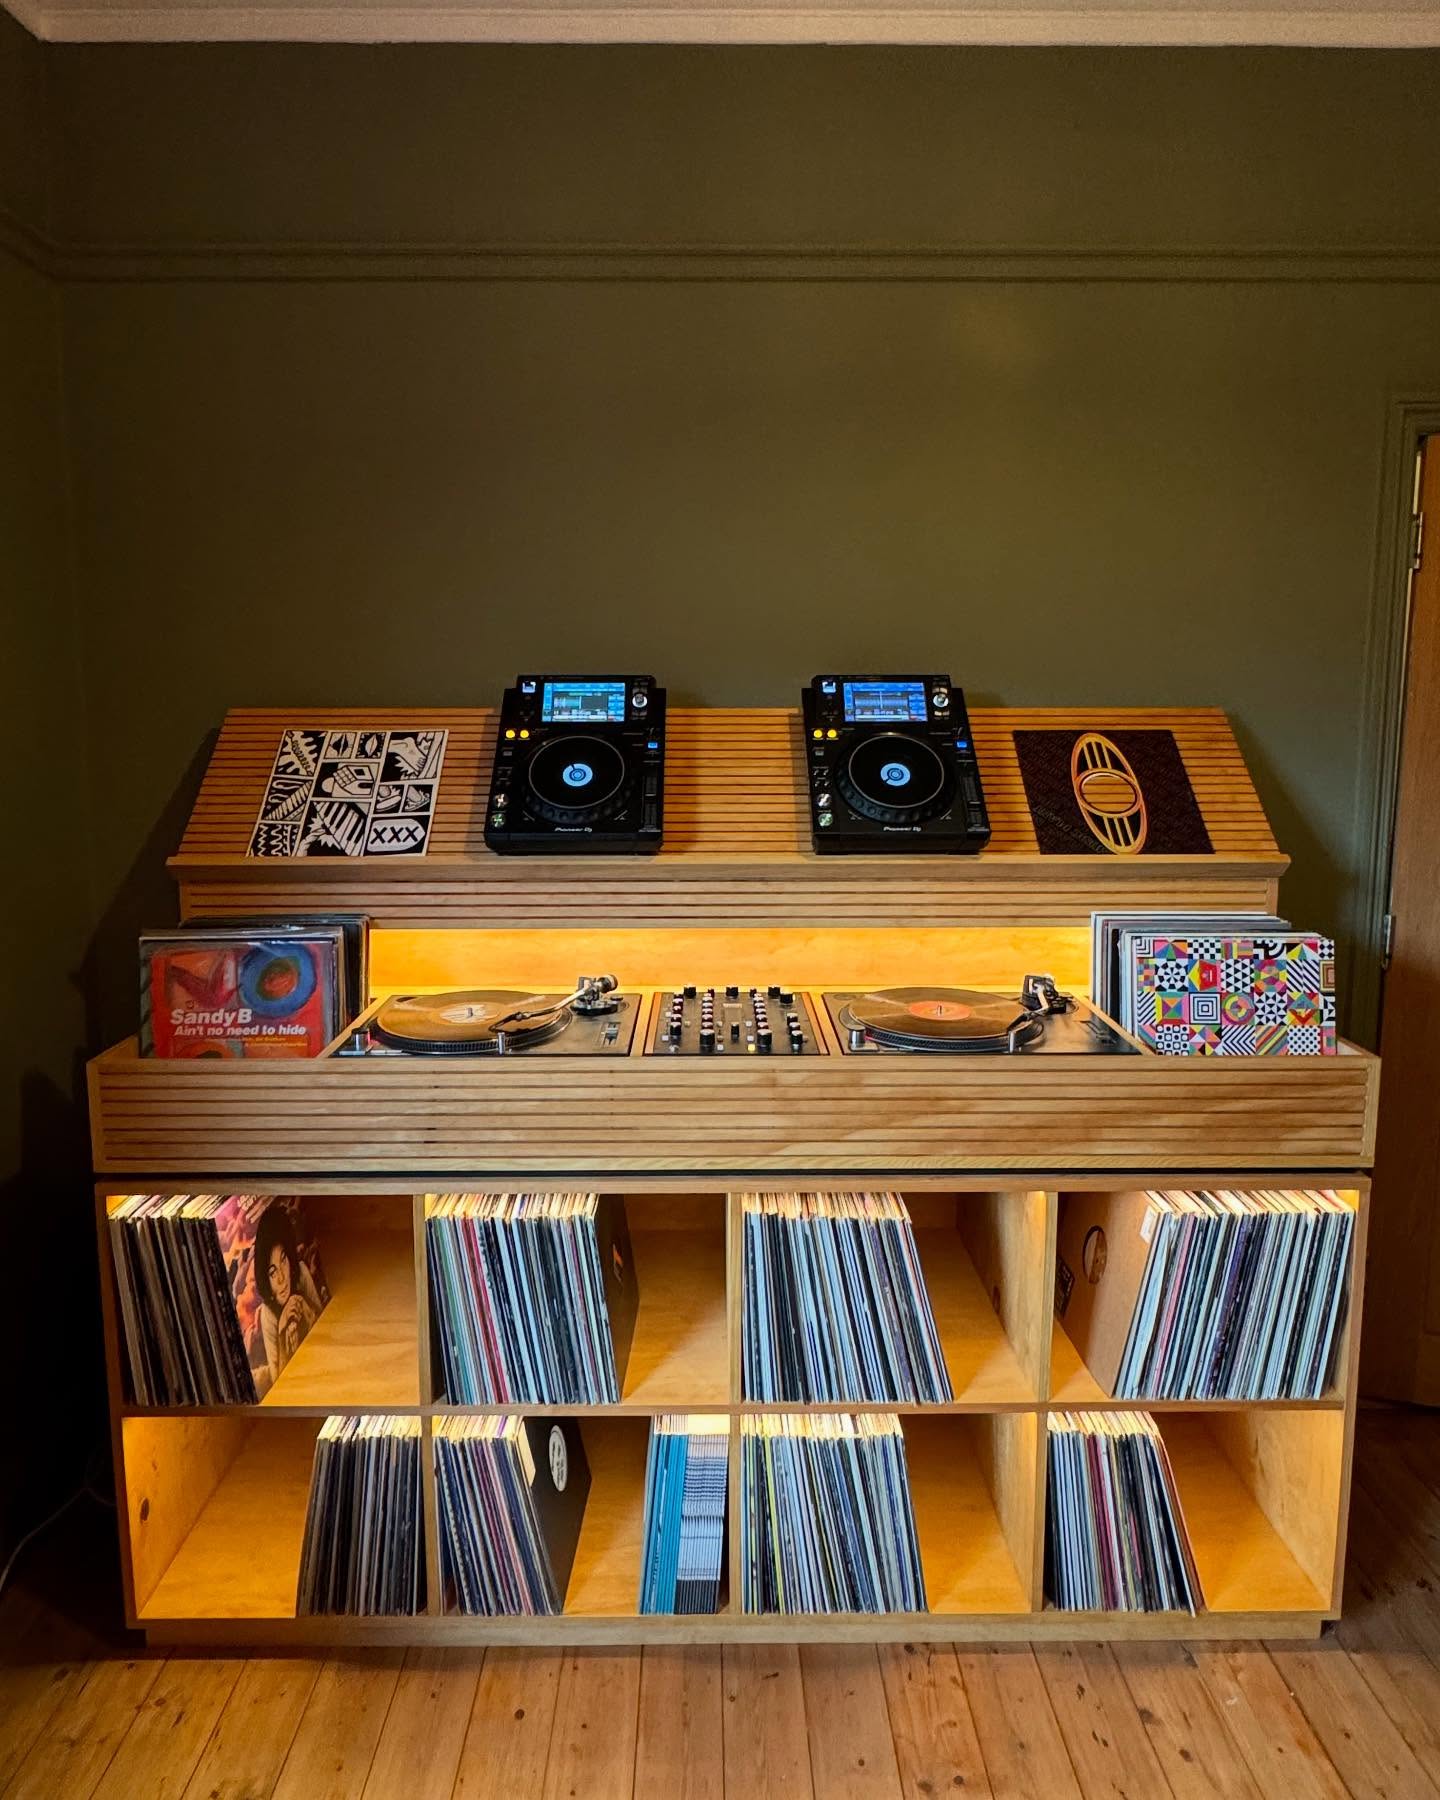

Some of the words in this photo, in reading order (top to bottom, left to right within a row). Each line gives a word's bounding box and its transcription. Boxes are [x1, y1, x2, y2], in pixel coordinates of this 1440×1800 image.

[370, 826, 420, 844] XXX
[174, 1025, 204, 1036] Ain't
[206, 1026, 224, 1036] no
[226, 1024, 260, 1036] need
[262, 1024, 276, 1036] to
[278, 1024, 307, 1036] hide
